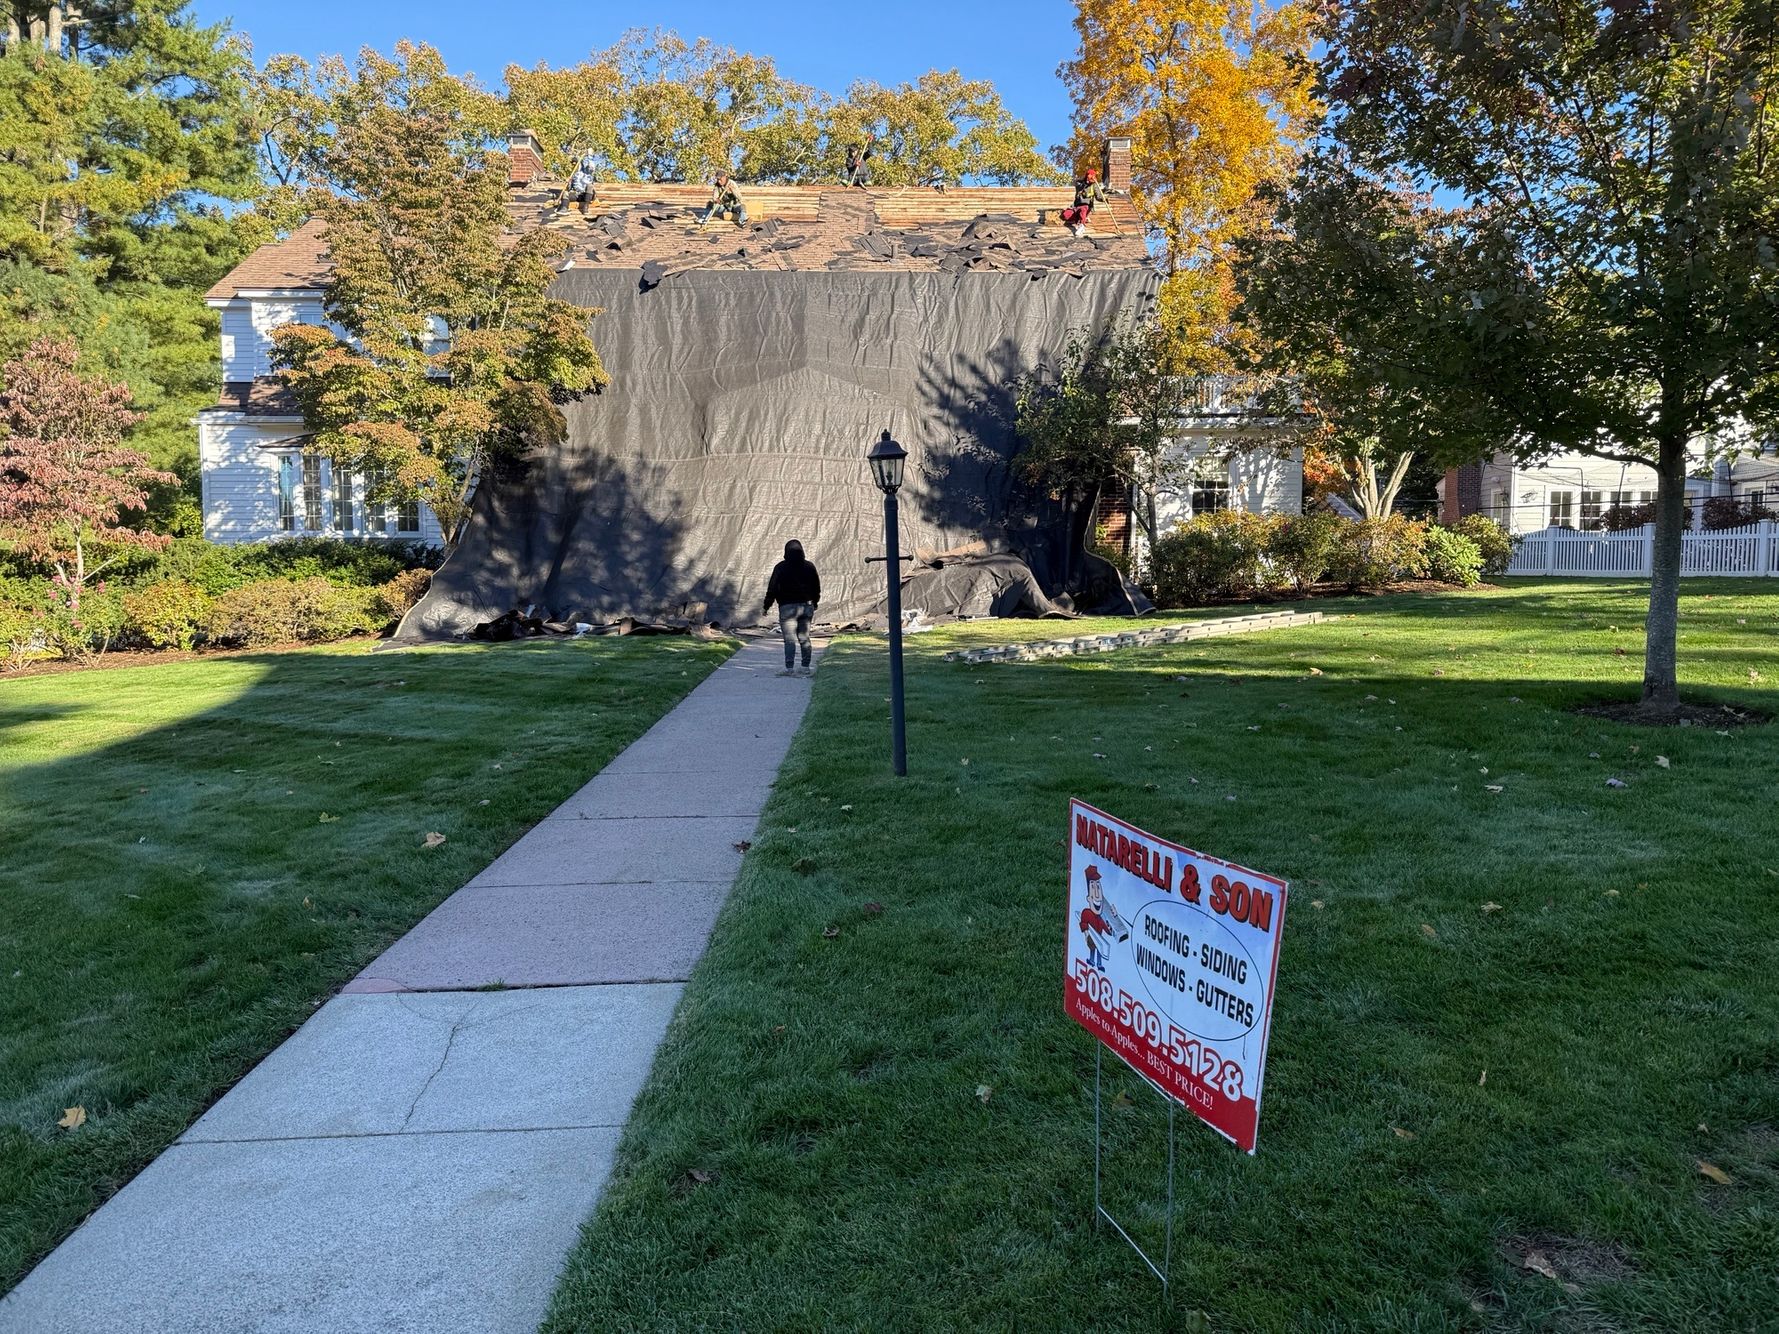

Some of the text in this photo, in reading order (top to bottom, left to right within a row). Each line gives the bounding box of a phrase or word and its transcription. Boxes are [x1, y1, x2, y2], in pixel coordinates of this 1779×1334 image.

[1076, 813, 1273, 932] NATARELLI & SON
[1136, 942, 1185, 993] WINDOWS
[1196, 979, 1254, 1028] GUTTERS
[1144, 914, 1190, 959] ROOFING
[1200, 944, 1247, 985] SIDING
[1074, 958, 1244, 1102] 508.509.5128
[1075, 998, 1101, 1025] Apples
[1147, 1050, 1173, 1078] BEST
[1175, 1070, 1214, 1110] PRICE!
